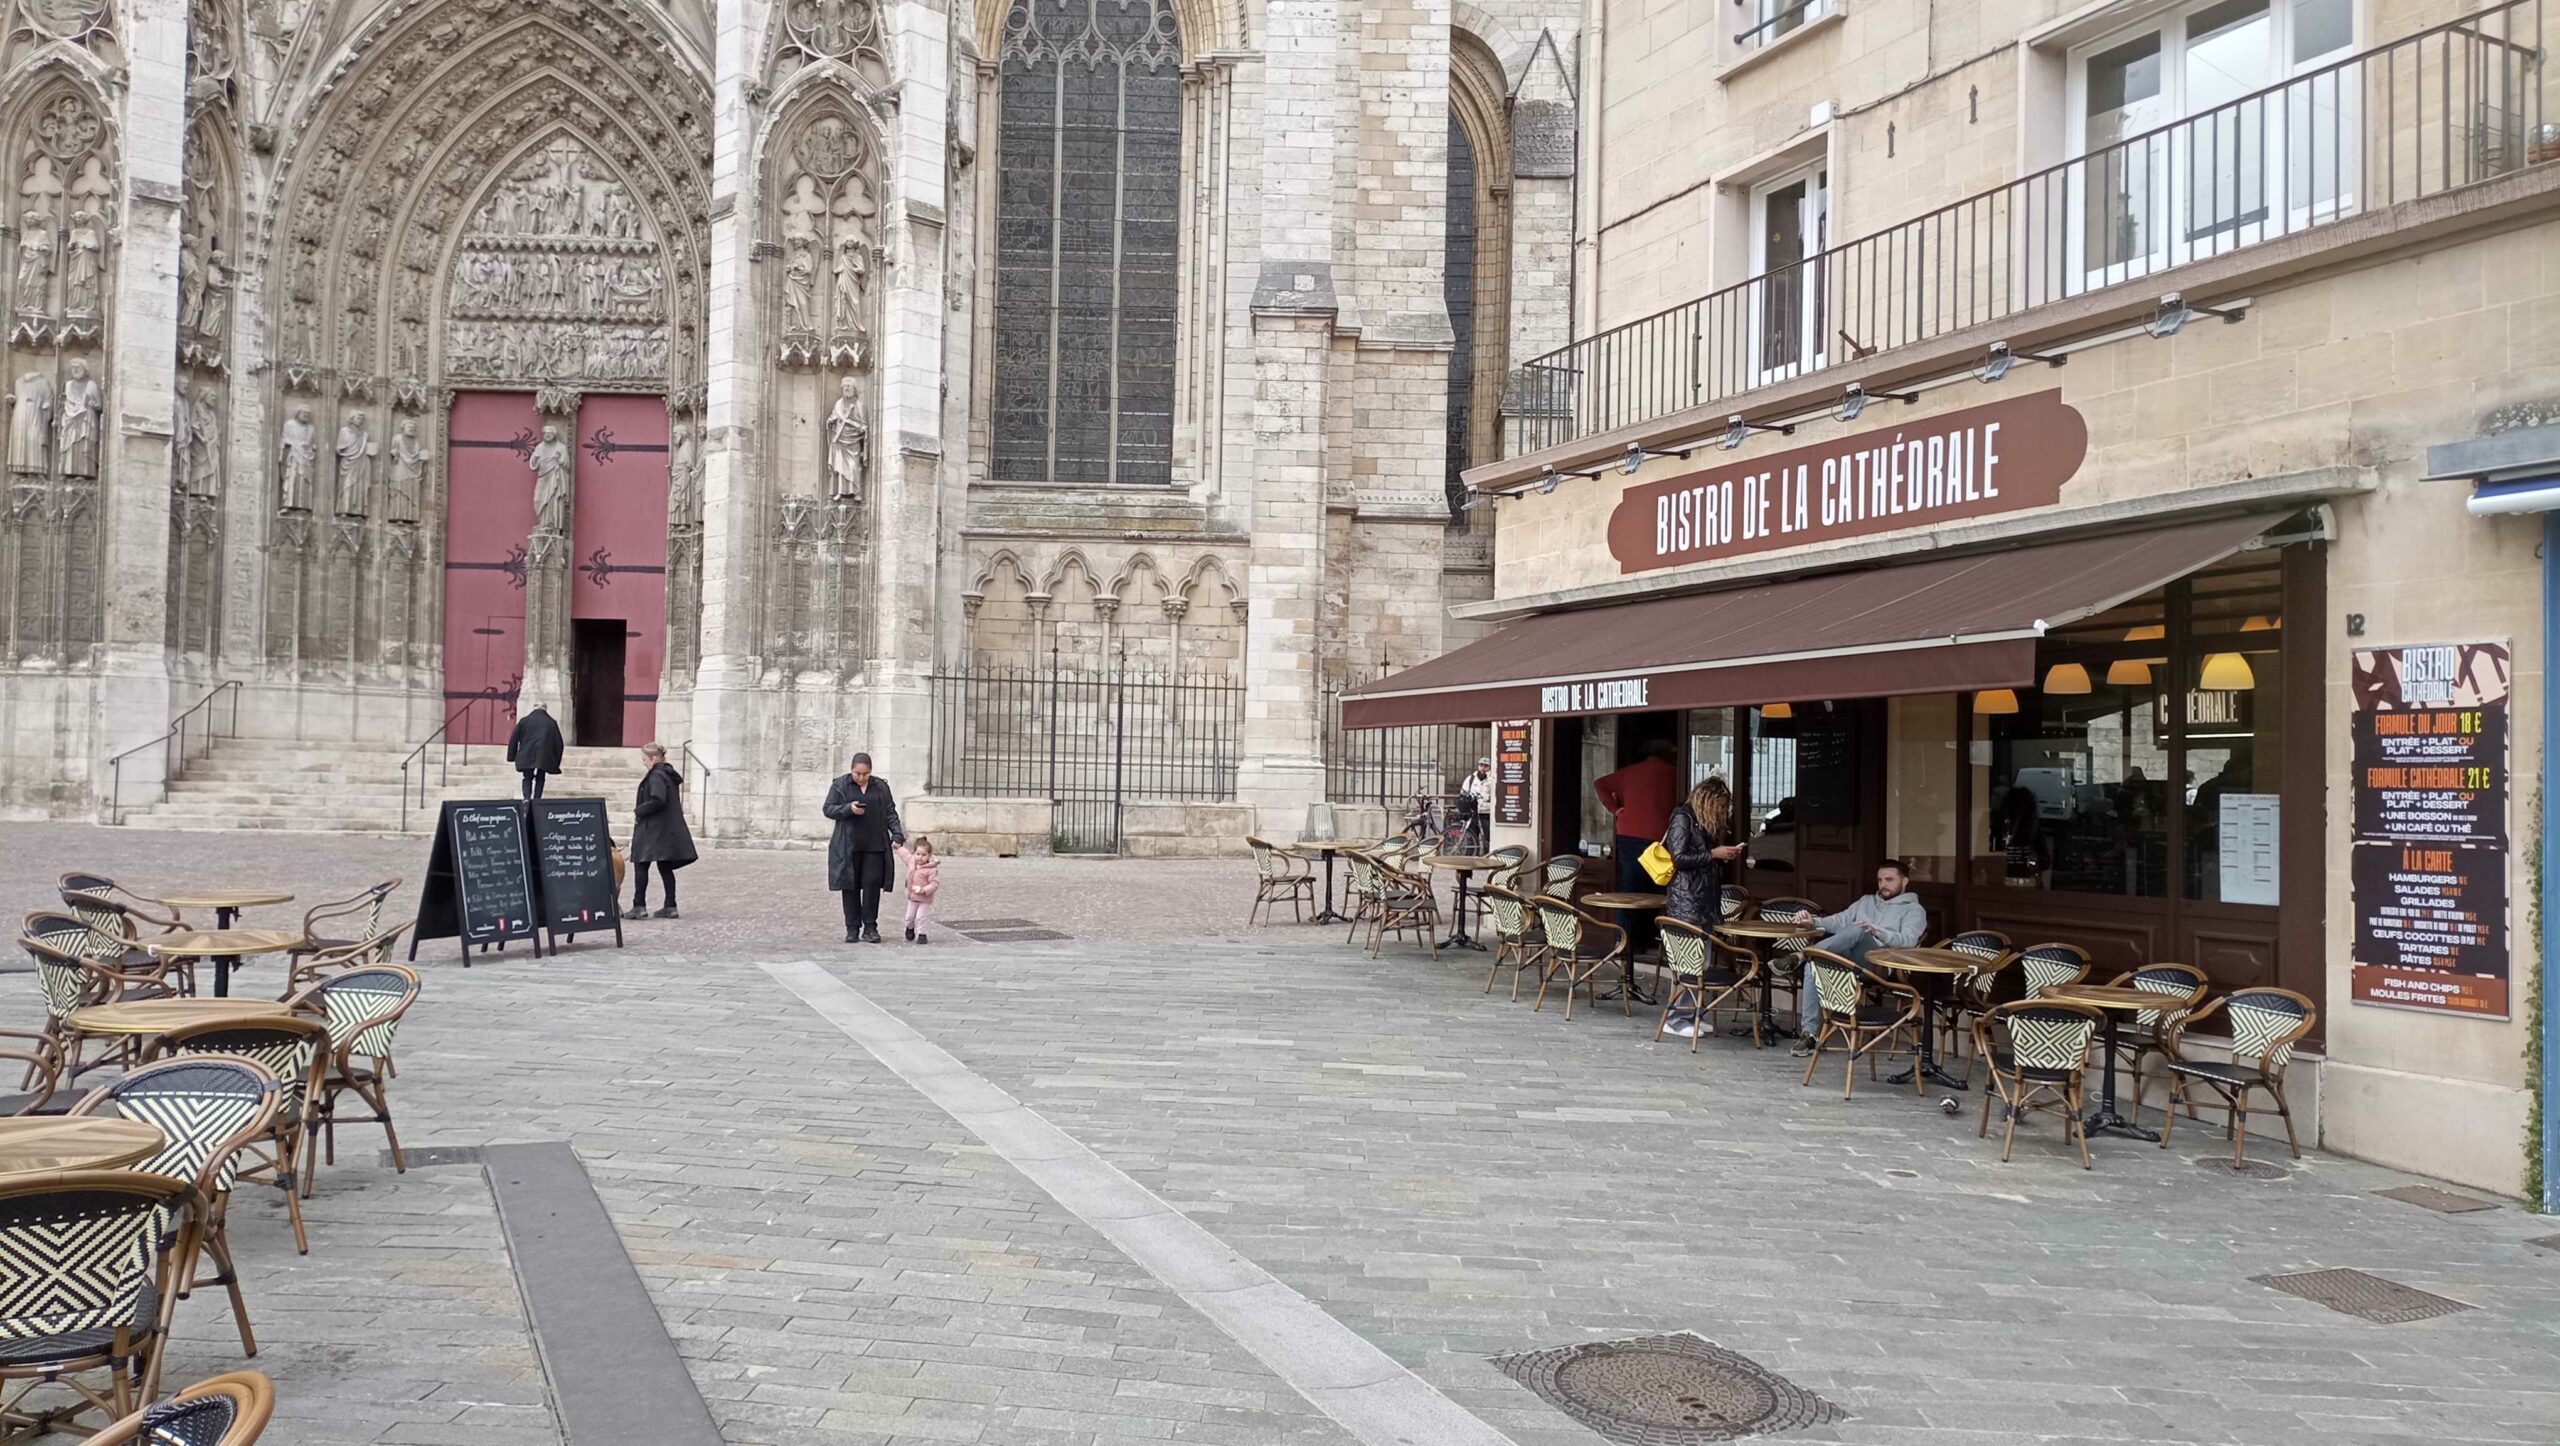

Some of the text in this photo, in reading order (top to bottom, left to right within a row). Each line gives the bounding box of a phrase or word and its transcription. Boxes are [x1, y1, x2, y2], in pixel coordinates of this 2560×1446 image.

[1656, 422, 2000, 555] BISTRO DE LA CATHÉDRALE
[2346, 613, 2365, 637] 12
[2402, 647, 2454, 681] BISTRO
[1542, 685, 1568, 712] BISTRO
[1571, 684, 1581, 711] DE
[1584, 683, 1594, 710] LA
[2375, 712, 2482, 735] FORMULE DU JOUR 18 €
[2381, 736, 2420, 746] ENTRÉE
[2458, 737, 2474, 745] OU
[2423, 746, 2469, 755] DESSERT
[2367, 767, 2407, 788] FORMULE
[2467, 767, 2480, 789] 21
[2482, 767, 2490, 789] €
[2381, 790, 2420, 800] ENTRÉE
[2459, 792, 2474, 800] OU
[2423, 800, 2469, 809] DESSERT
[2386, 811, 2407, 820] UNE
[2407, 812, 2452, 821] BOISSON
[2391, 823, 2406, 831] UN
[2407, 822, 2433, 832] CAFÉ
[2434, 823, 2449, 832] OU
[2451, 822, 2472, 833] THÉ
[2411, 850, 2421, 871] LA
[2424, 850, 2453, 872] CARTE
[2388, 873, 2458, 885] HAMBURGERS
[2394, 885, 2440, 895] SALADES
[2400, 897, 2455, 908] GRILLADES
[2404, 931, 2460, 944] COCOTTES
[2397, 943, 2449, 955] TARTARES
[2400, 953, 2432, 965] PÂTES
[2384, 978, 2406, 988] FISH
[2407, 980, 2429, 990] AND
[2429, 982, 2461, 994] CHIPS
[2370, 988, 2410, 1001] MOULES
[2411, 992, 2446, 1005] FRITES
